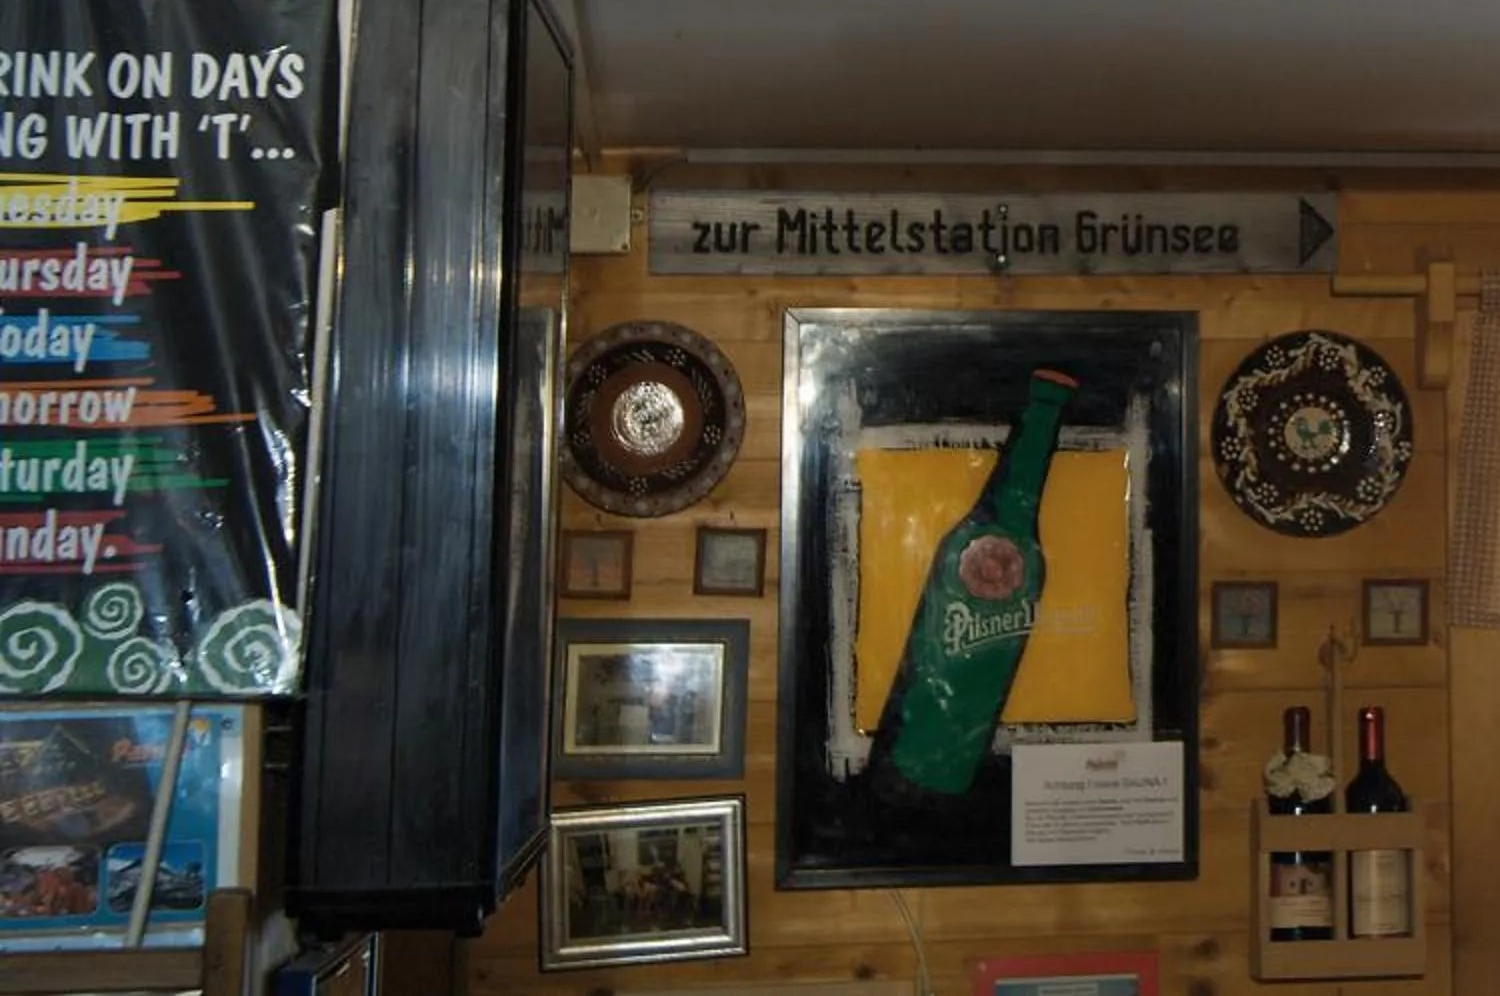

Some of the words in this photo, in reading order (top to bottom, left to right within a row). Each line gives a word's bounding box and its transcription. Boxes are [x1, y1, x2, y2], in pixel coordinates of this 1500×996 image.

[108, 52, 172, 99] ON
[191, 52, 305, 101] DAYS
[66, 111, 180, 160] WITH
[690, 217, 756, 255] zur
[775, 208, 1061, 257] Mittelstation
[1074, 209, 1241, 255] Grünsee
[0, 307, 96, 373] oday
[943, 600, 1023, 657] Pilsner
